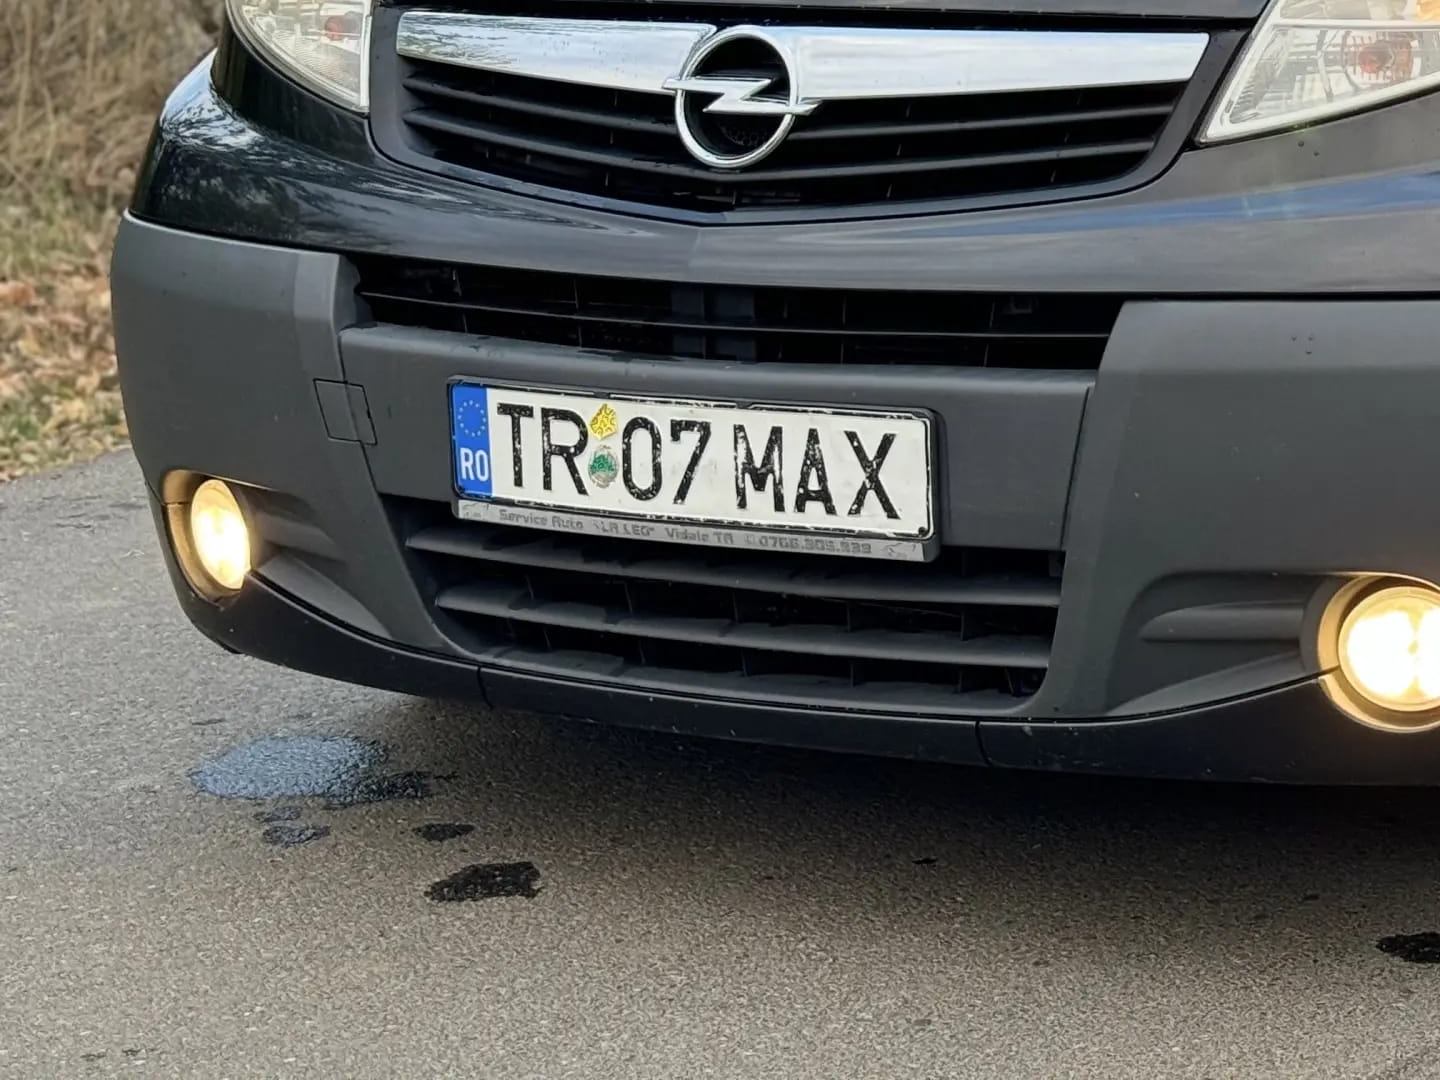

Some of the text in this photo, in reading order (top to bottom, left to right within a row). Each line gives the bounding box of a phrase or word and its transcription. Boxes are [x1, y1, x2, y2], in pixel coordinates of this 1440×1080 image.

[459, 447, 490, 482] RO
[497, 402, 901, 520] TR 07 MAX
